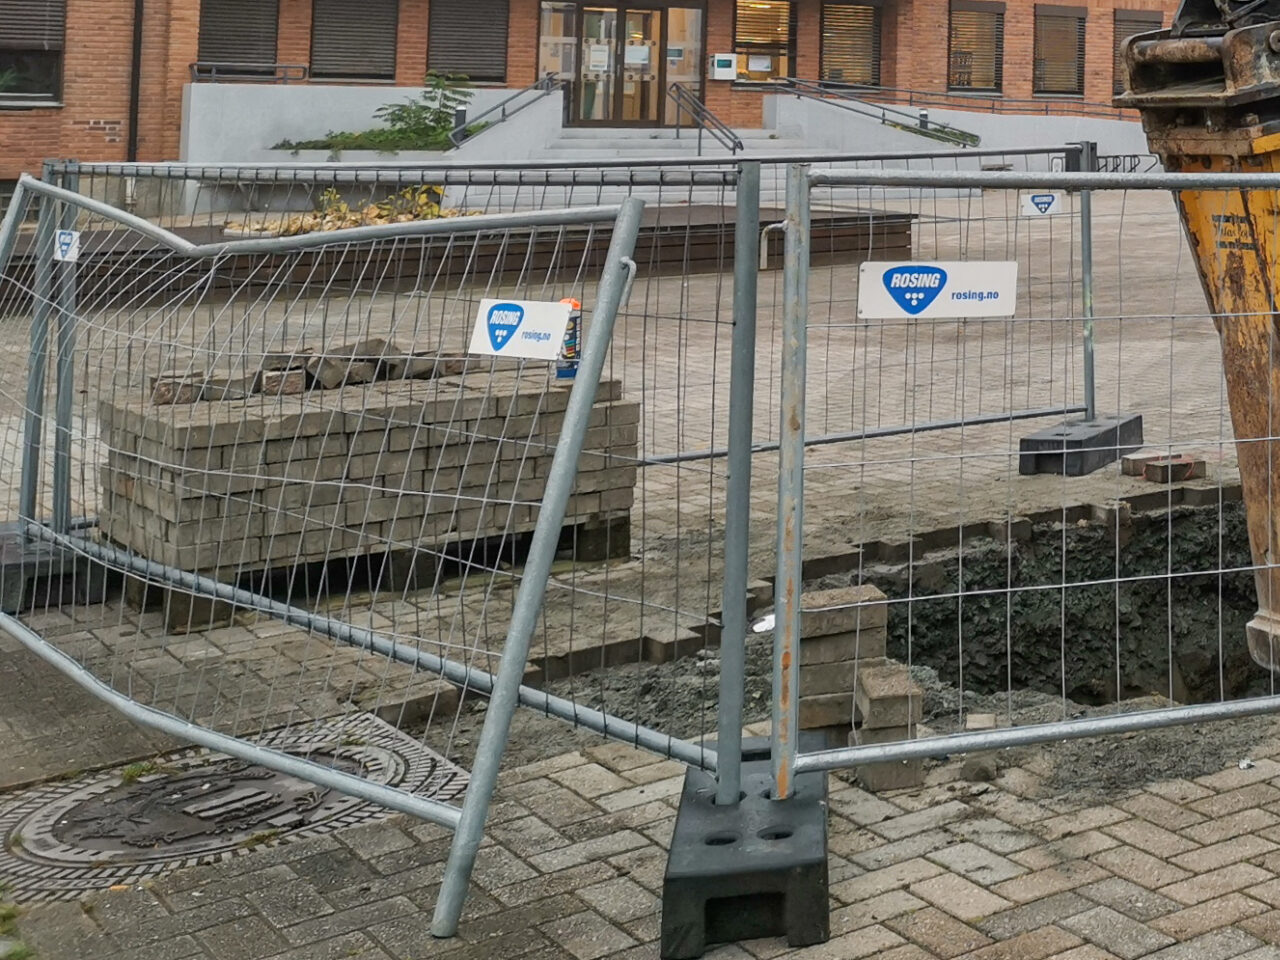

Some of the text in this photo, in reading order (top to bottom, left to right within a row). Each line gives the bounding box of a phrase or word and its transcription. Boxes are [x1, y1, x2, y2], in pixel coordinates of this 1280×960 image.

[890, 272, 940, 289] ROSING
[951, 290, 999, 301] rosing.no
[489, 309, 521, 326] ROSING
[521, 330, 551, 342] rosing.no
